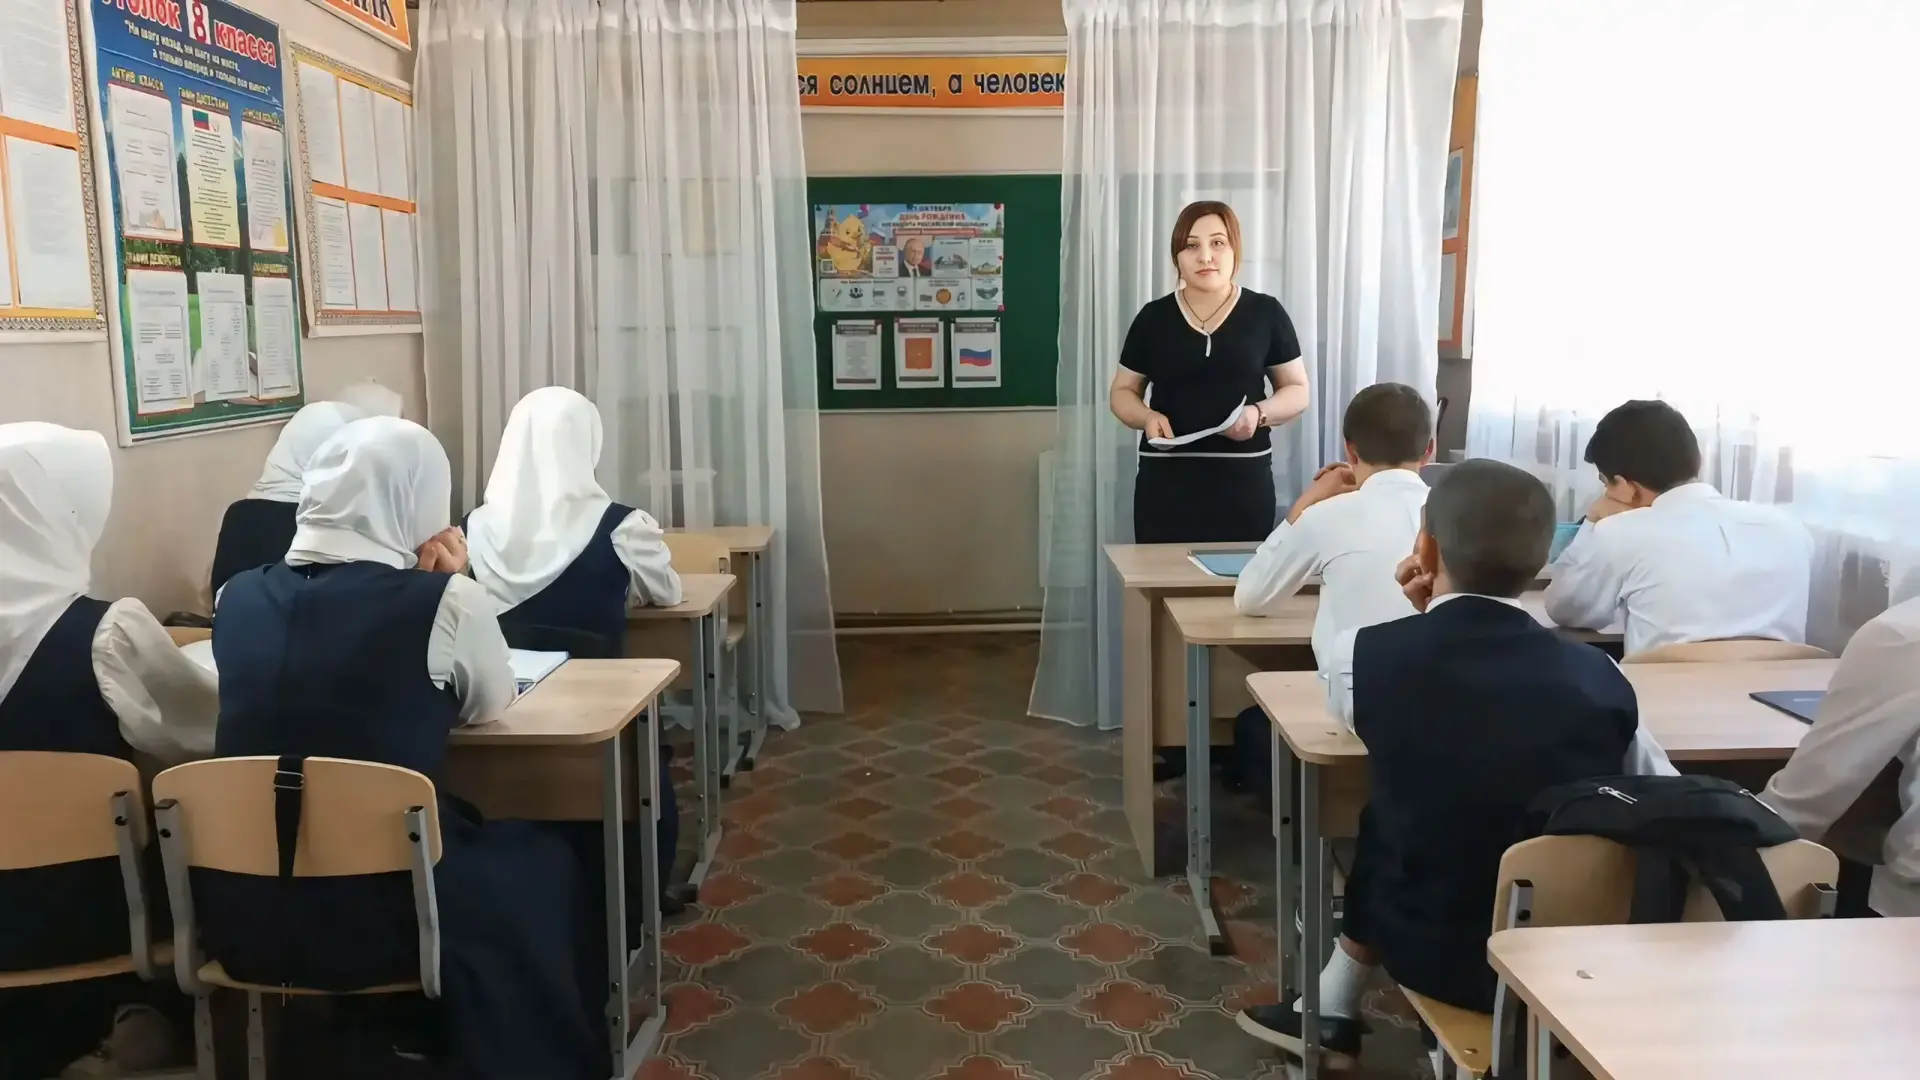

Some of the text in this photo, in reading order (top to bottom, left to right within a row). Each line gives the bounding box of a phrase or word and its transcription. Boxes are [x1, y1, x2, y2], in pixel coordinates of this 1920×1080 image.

[101, 0, 277, 68] олок 8 класса
[111, 66, 136, 84] АКТИВ
[829, 73, 937, 98] солнцем,
[948, 74, 963, 94] а
[973, 72, 1065, 94] человек
